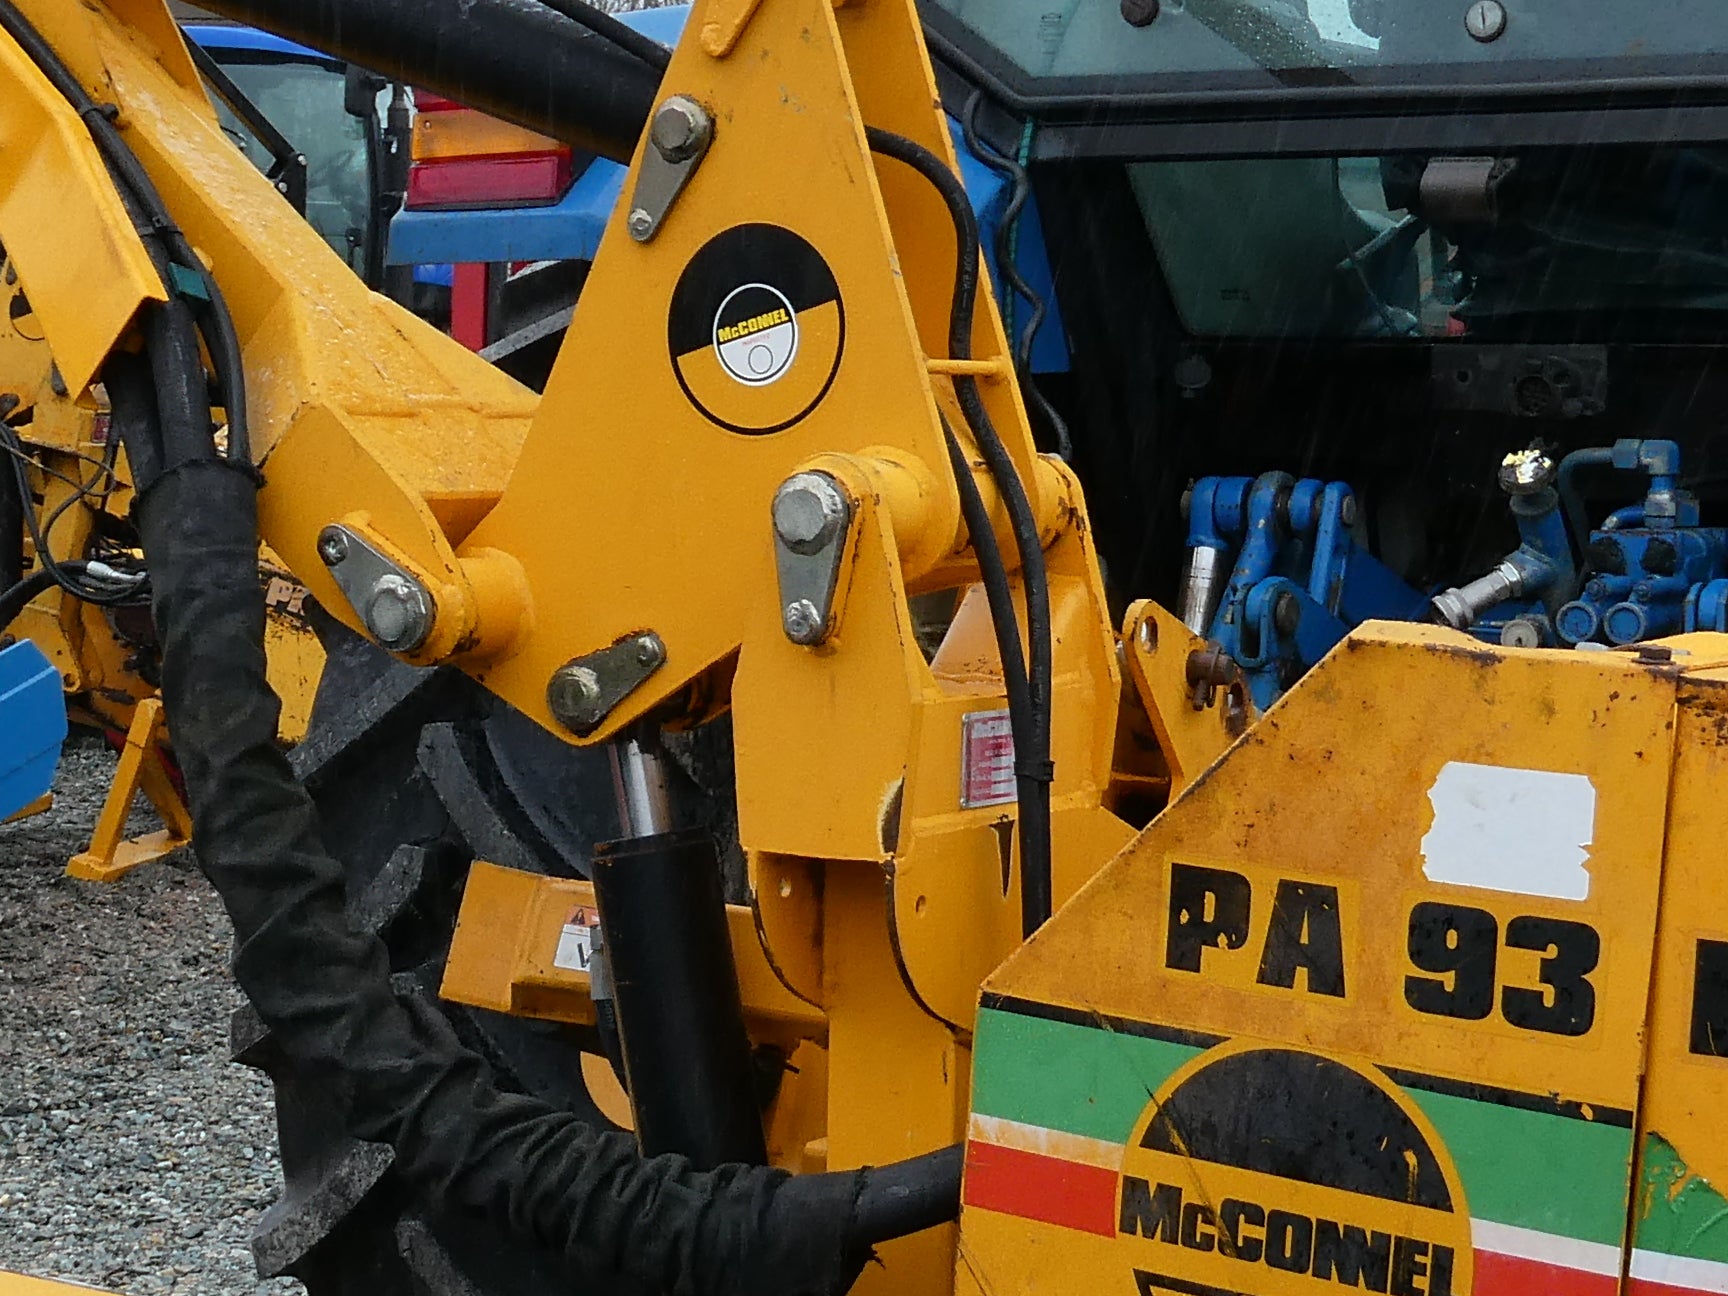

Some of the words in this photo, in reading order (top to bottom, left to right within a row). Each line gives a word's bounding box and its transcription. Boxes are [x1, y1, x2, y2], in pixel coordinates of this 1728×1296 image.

[717, 307, 790, 343] McCONNEL
[1165, 862, 1346, 999] PA
[1403, 901, 1600, 1037] 93
